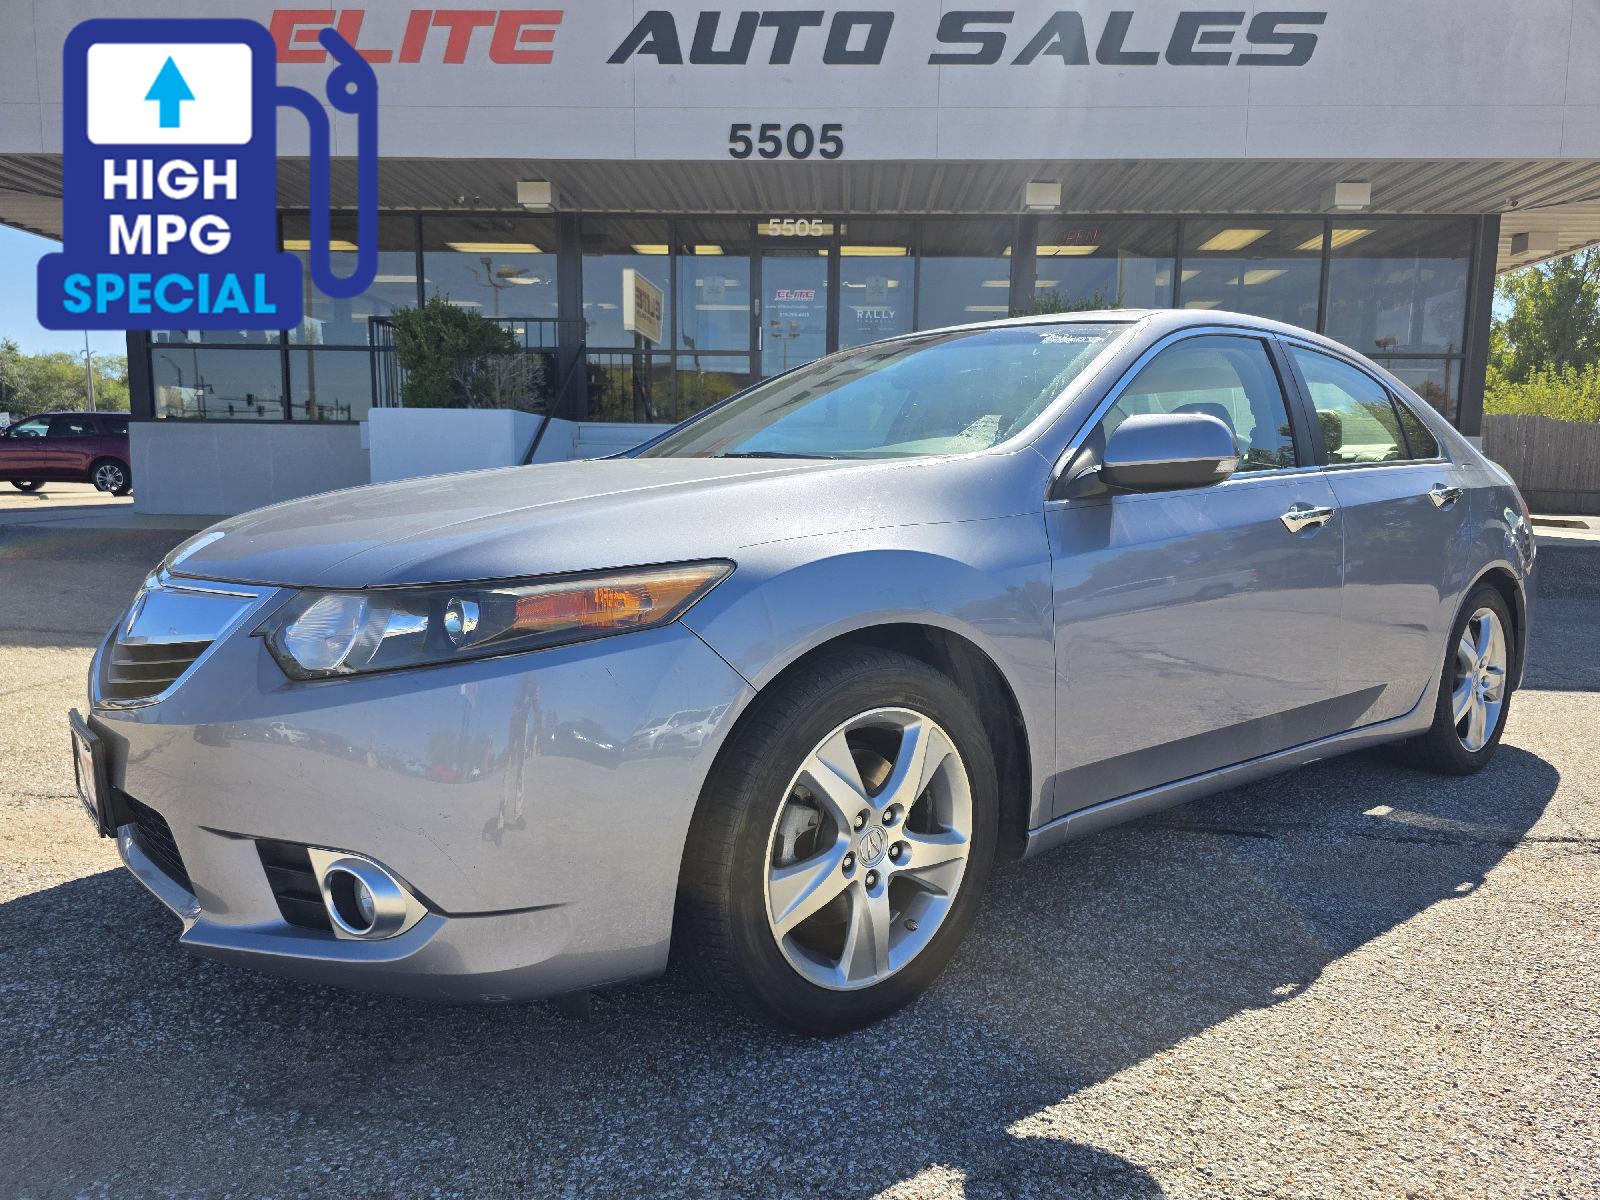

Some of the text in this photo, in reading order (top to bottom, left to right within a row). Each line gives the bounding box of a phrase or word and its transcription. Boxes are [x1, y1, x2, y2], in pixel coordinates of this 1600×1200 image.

[269, 10, 1327, 66] ELITE AUTO SALES
[728, 123, 845, 159] 5505
[768, 218, 824, 236] 5505
[776, 290, 815, 300] ELITE
[856, 310, 895, 319] RALLY
